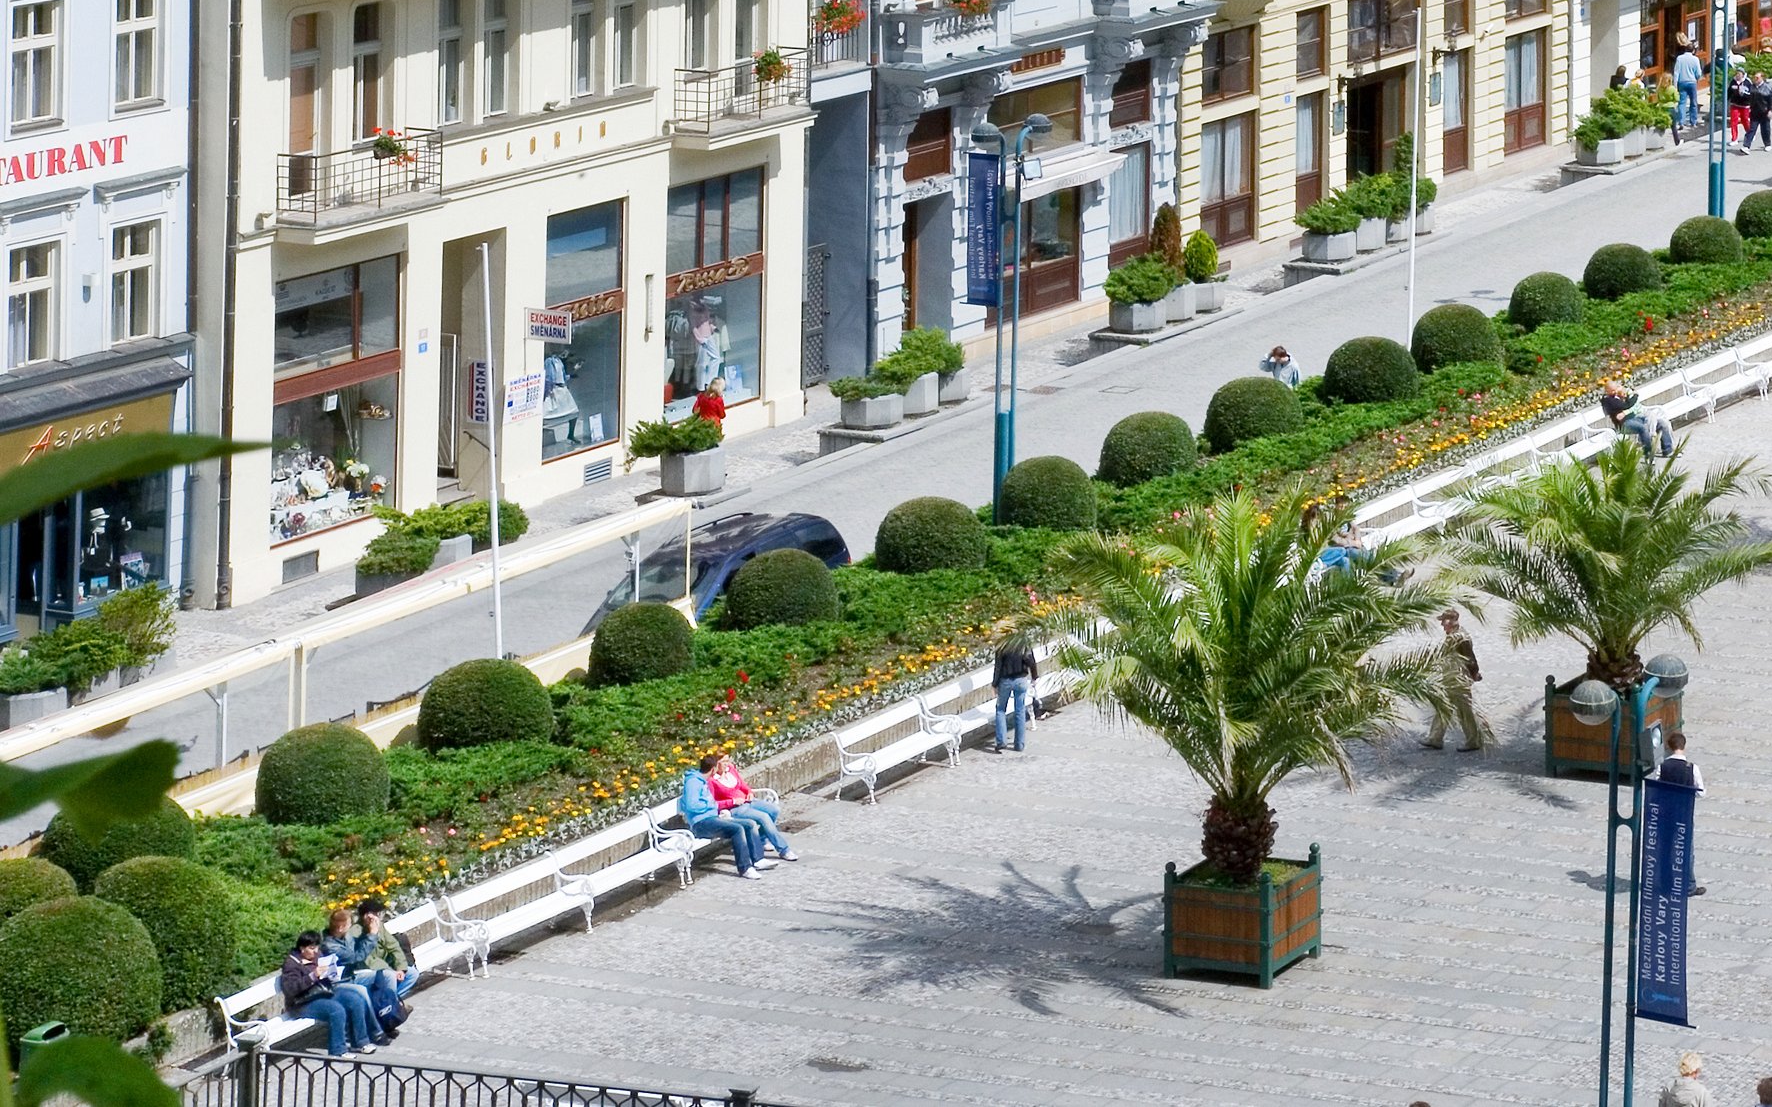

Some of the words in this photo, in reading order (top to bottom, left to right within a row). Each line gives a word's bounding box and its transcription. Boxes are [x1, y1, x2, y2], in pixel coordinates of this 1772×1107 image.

[530, 312, 567, 327] EXCHANGE
[530, 325, 566, 340] SMĚNÁRNA
[475, 362, 487, 423] EXCHANGE
[21, 413, 124, 465] Aspect
[1646, 802, 1659, 851] festival
[1672, 822, 1686, 872] Festival
[1643, 853, 1657, 899] filmový
[1671, 877, 1682, 903] Film
[1656, 895, 1669, 928] Vary
[1641, 903, 1651, 980] Mezinárodní
[1655, 930, 1667, 982] Karlovy
[1670, 907, 1681, 985] International
